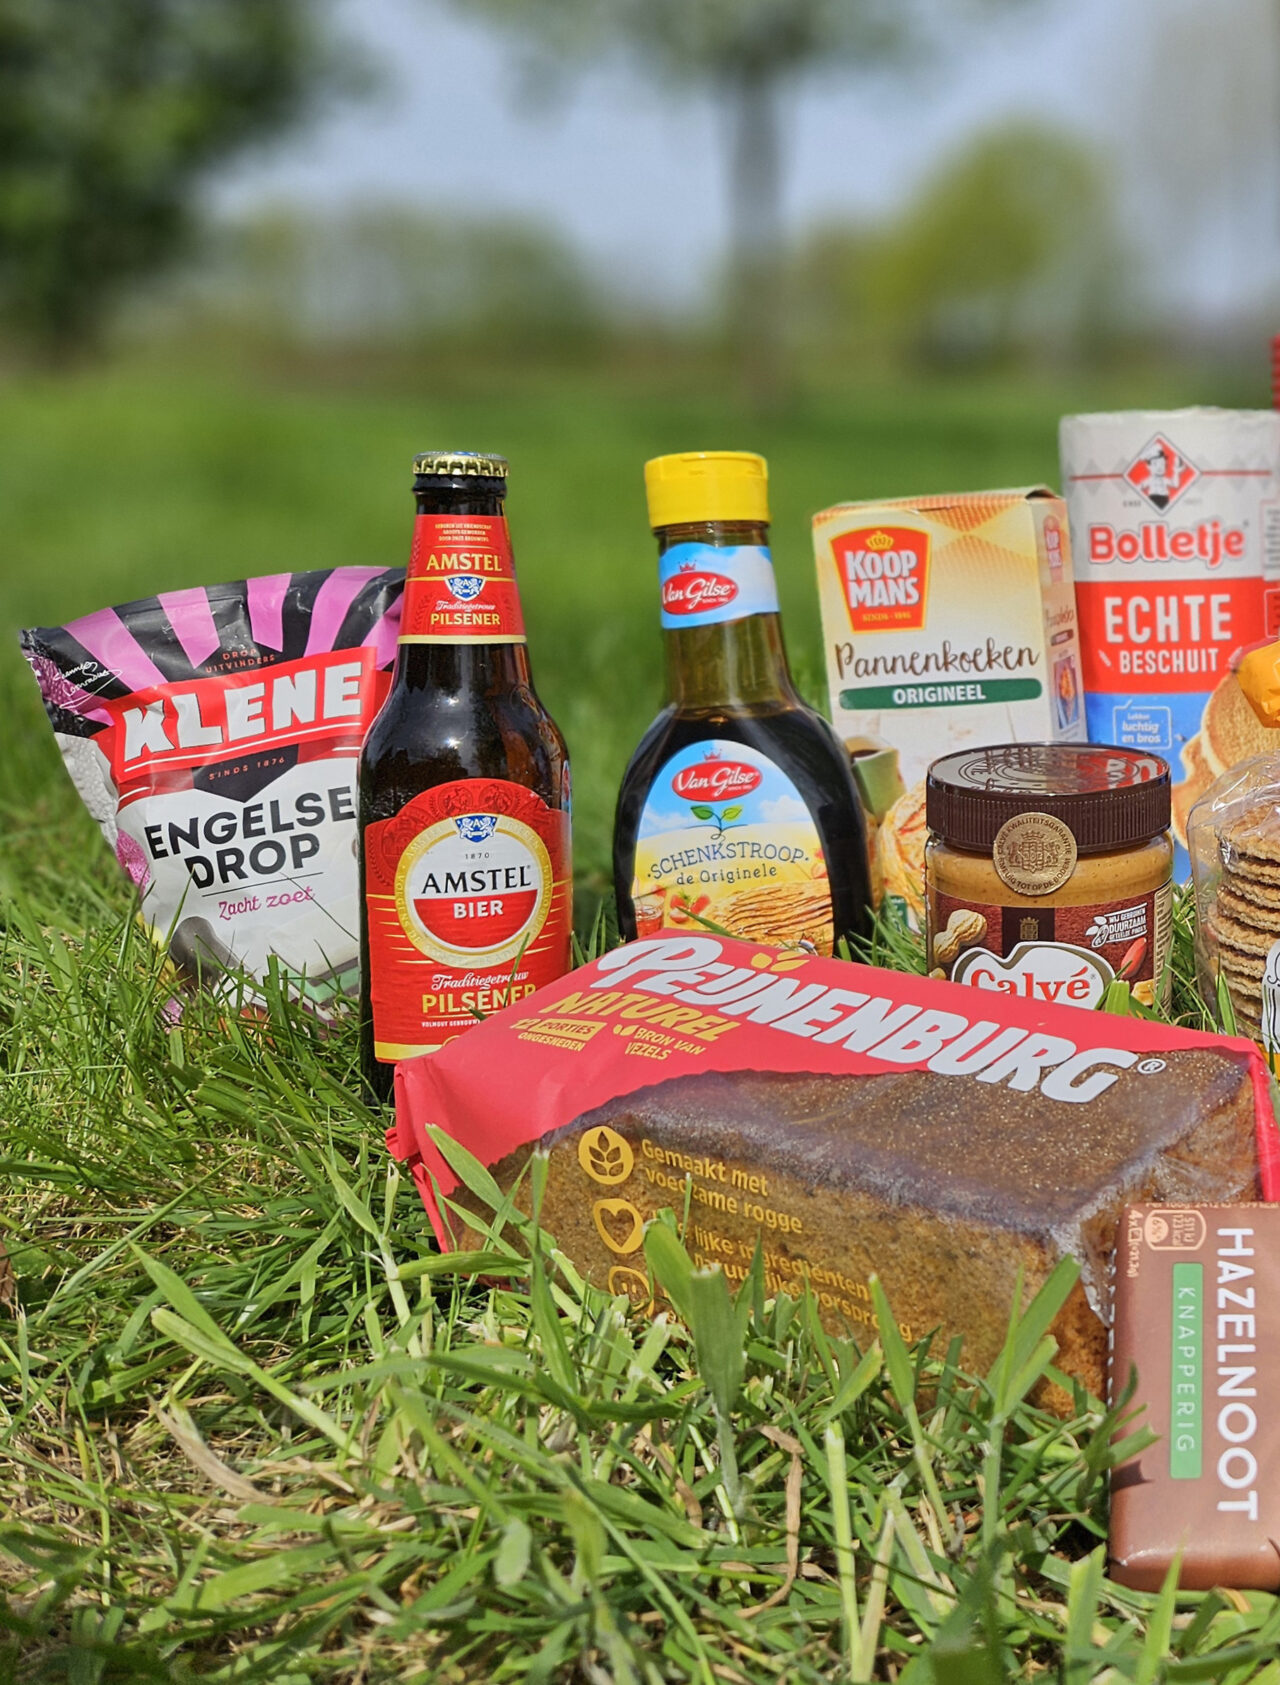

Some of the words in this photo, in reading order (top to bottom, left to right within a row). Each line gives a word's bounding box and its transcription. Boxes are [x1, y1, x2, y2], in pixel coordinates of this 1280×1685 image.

[1089, 519, 1246, 570] Bolletje
[426, 552, 503, 572] AMSTEL
[844, 549, 918, 581] KOOP
[685, 577, 732, 610] Gilse
[848, 577, 920, 609] MANS
[430, 612, 501, 626] PILSENER
[1104, 593, 1233, 644] ECHTE
[204, 654, 276, 674] UITVINDERS
[221, 648, 258, 661] DROP
[835, 637, 1040, 681] Pannenkoeken
[1119, 648, 1219, 676] BESCHUIT
[892, 684, 987, 705] ORIGINEEL
[121, 660, 362, 763] KLENE
[1121, 735, 1135, 744] en
[1136, 733, 1161, 744] bros
[1122, 719, 1160, 734] luchtig
[208, 764, 250, 781] SINDS
[256, 756, 286, 770] 1876
[677, 771, 710, 792] Van
[710, 766, 756, 797] Gilse
[143, 785, 358, 861] ENGELSE
[183, 832, 321, 890] DROP
[465, 852, 490, 860] 1870
[650, 841, 806, 881] SCHENKSTROOP
[421, 867, 532, 894] AMSTEL
[676, 872, 695, 885] de
[700, 863, 777, 884] Originele
[1016, 880, 1031, 890] TOT
[1031, 883, 1043, 891] OP
[1042, 880, 1055, 890] DE
[218, 895, 262, 921] Zacht
[265, 885, 316, 908] zoet
[453, 899, 504, 920] BIER
[1109, 914, 1147, 934] DUURZAAM
[970, 965, 1091, 1000] Calvé
[510, 1018, 541, 1030] 12
[538, 1020, 597, 1036] PORTIES
[537, 991, 742, 1042] NATUREL
[624, 1041, 673, 1061] VEZELS
[634, 1028, 676, 1046] BRON
[674, 1040, 706, 1056] VAN
[641, 1138, 726, 1183] Gemaakt
[731, 1167, 770, 1197] met
[743, 1202, 803, 1235] rogge
[1176, 1287, 1197, 1452] KNAPPERIG
[1216, 1228, 1259, 1522] HAZELNOOT
